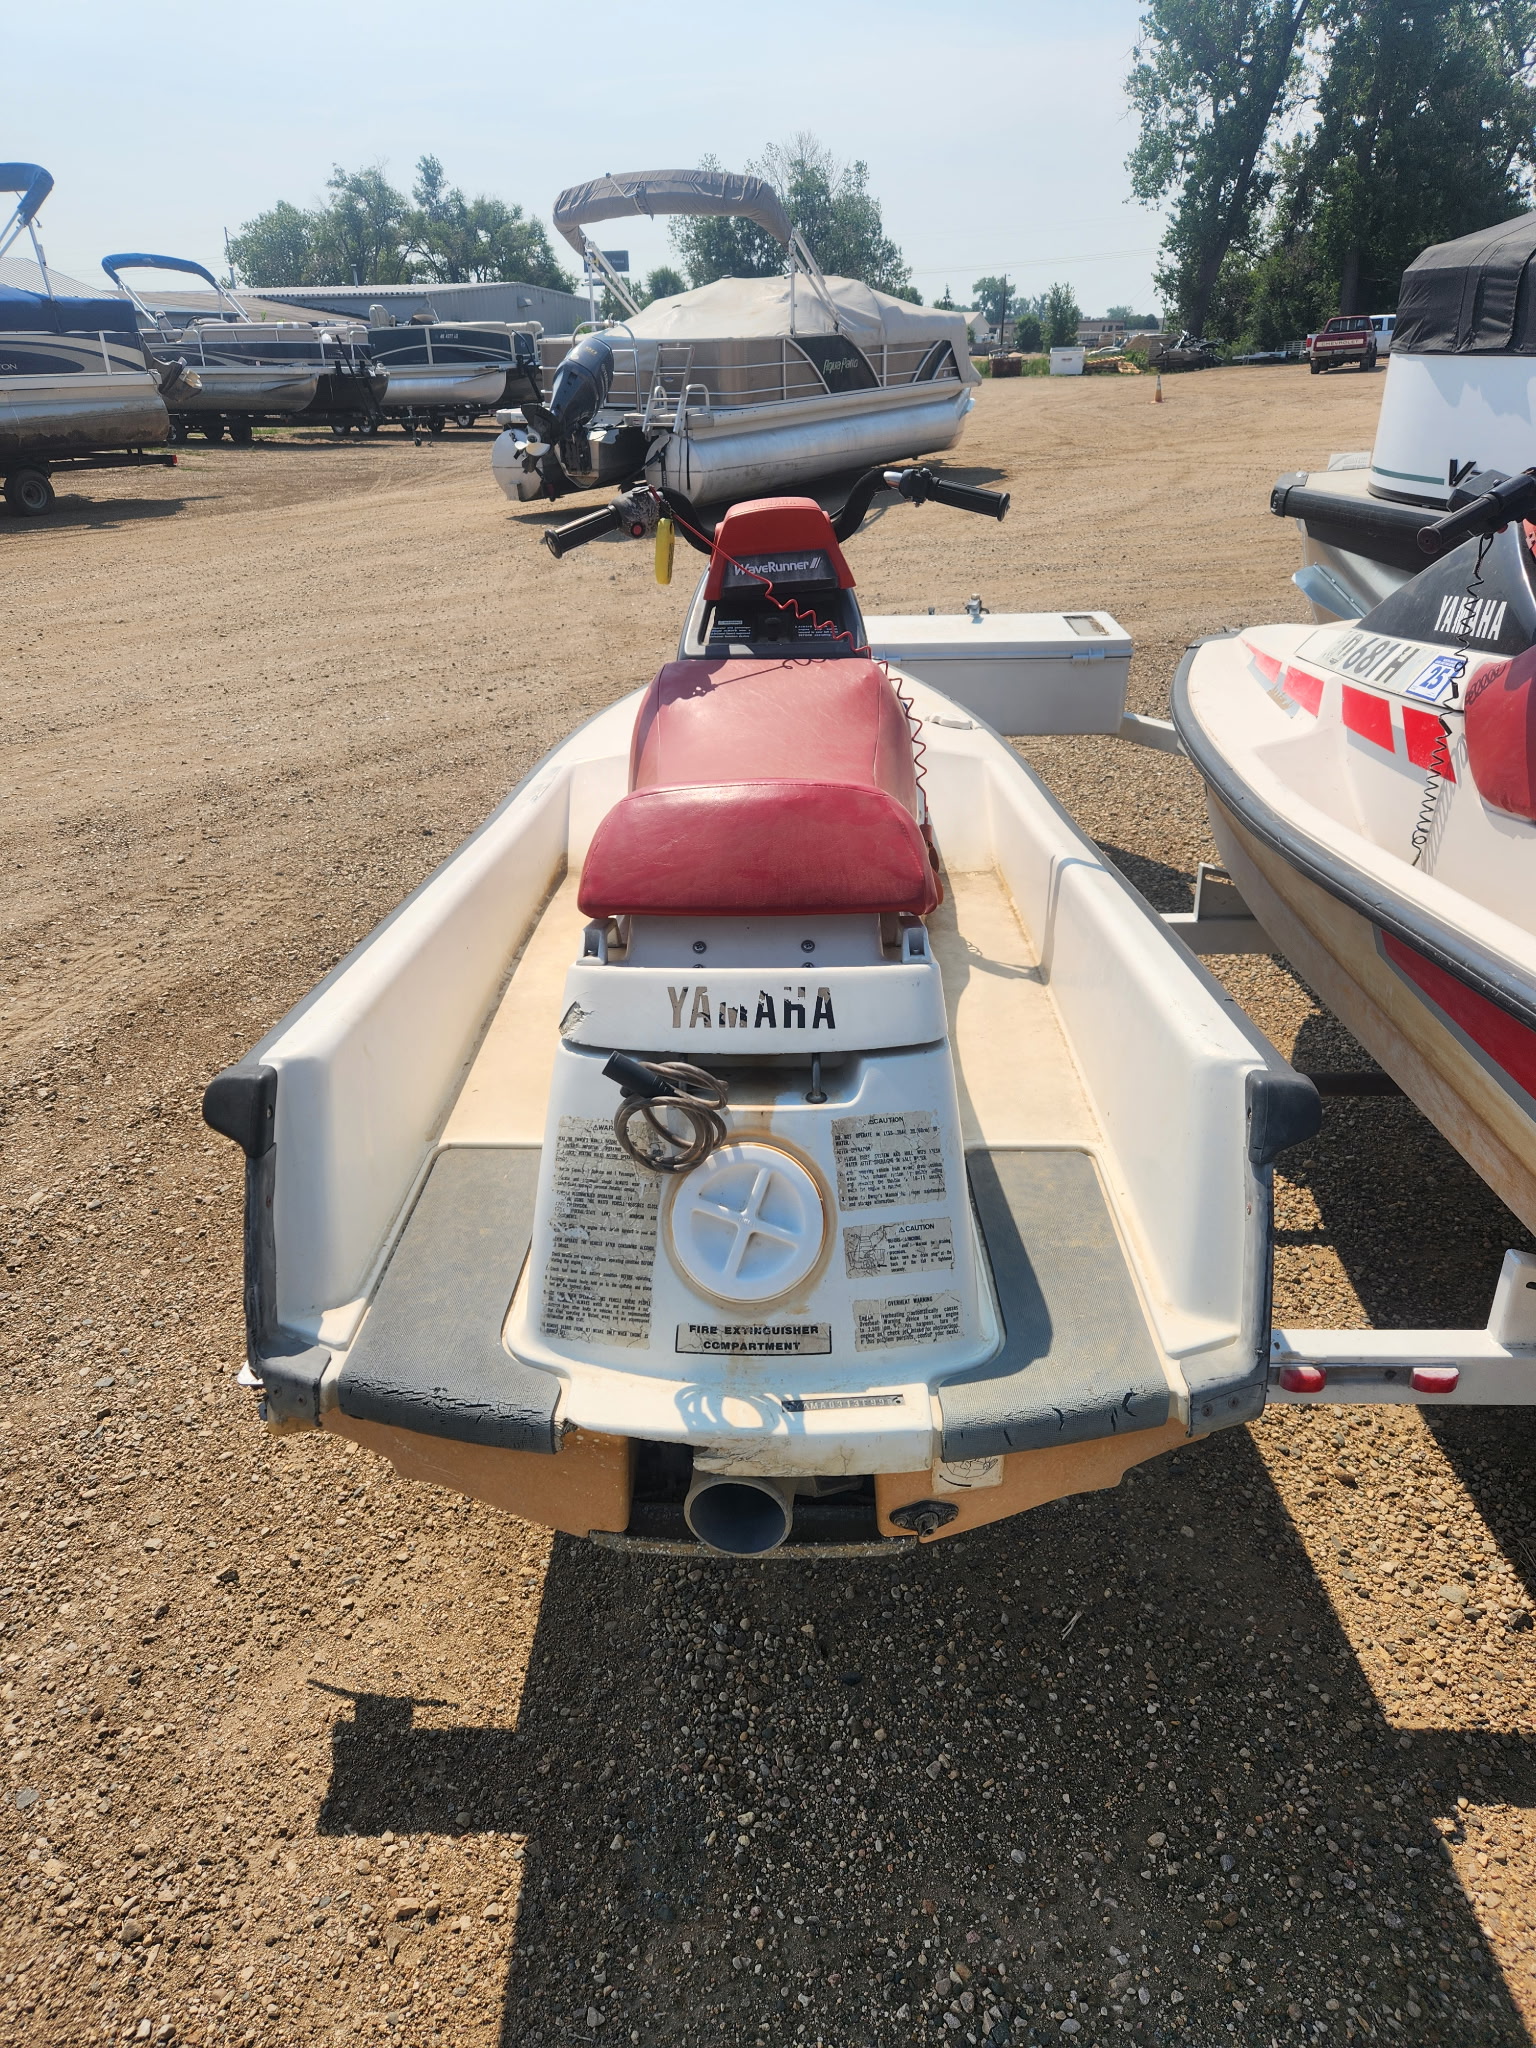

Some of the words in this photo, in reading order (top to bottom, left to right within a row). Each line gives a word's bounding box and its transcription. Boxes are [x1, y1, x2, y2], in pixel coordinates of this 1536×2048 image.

[734, 561, 809, 576] WaveRunner
[1434, 594, 1508, 640] YAMAHA
[1419, 666, 1451, 689] 25
[667, 986, 836, 1029] YAMAHA
[874, 1116, 904, 1125] CAUTION
[905, 1223, 935, 1232] CAUTION
[690, 1325, 718, 1334] FIRE
[724, 1326, 819, 1335] EXTINGUISHER
[704, 1341, 800, 1350] COMPARTMENT
